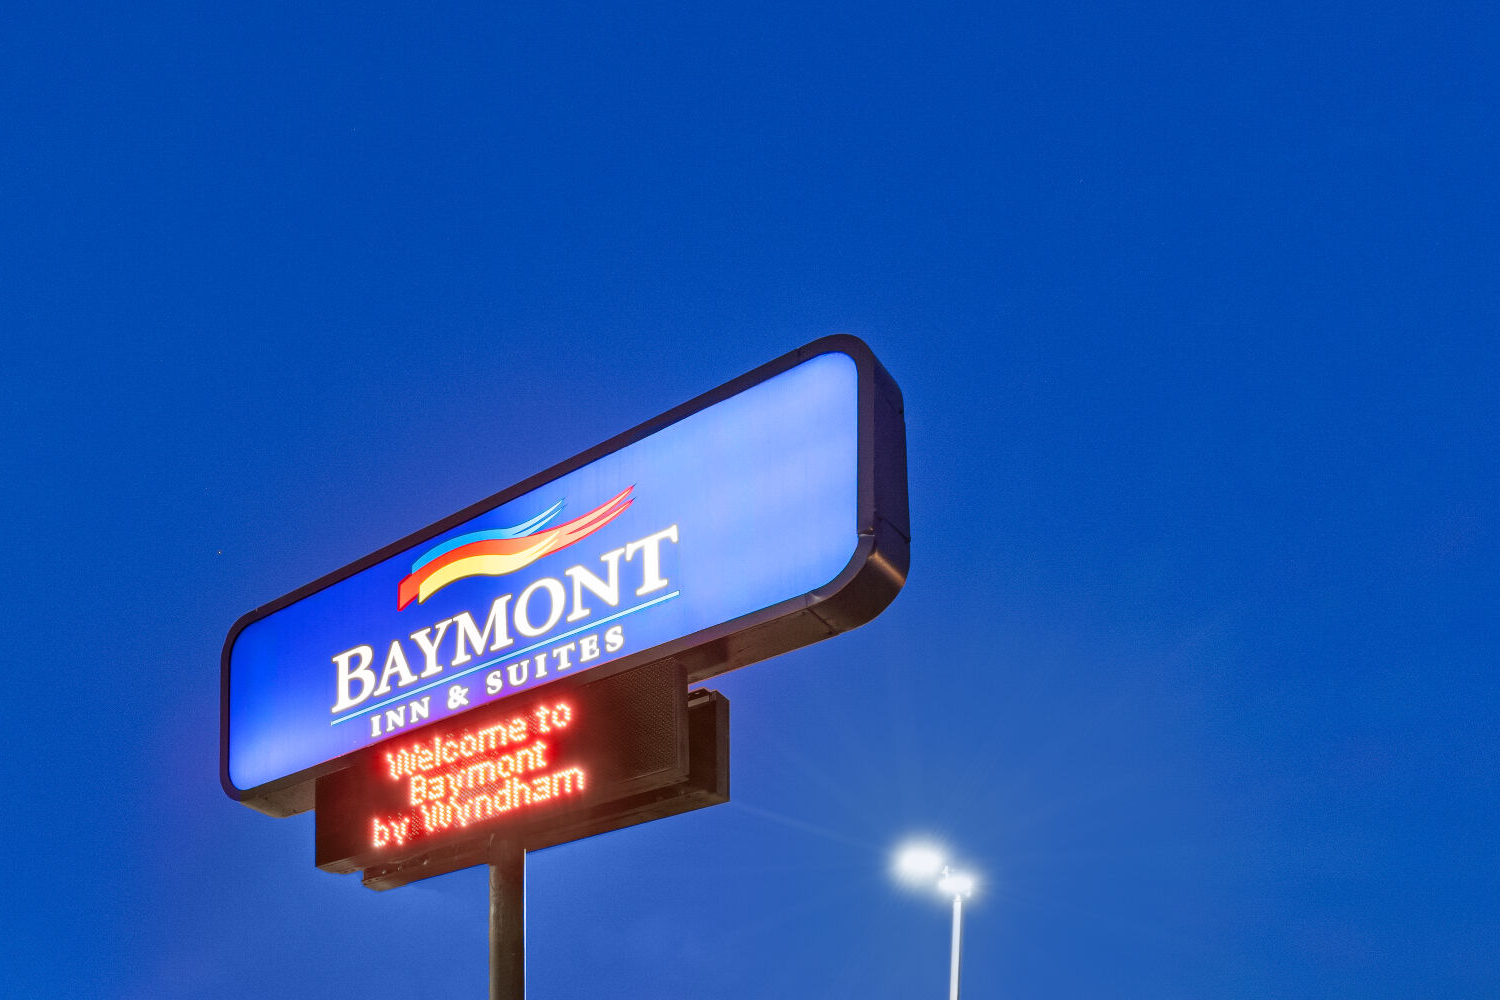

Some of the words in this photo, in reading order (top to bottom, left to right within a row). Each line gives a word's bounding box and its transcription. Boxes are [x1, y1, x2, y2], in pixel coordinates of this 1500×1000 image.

[331, 525, 678, 713] BAYMONT
[370, 697, 430, 738] INN
[447, 685, 469, 709] &
[485, 625, 625, 695] SUITES
[386, 718, 527, 780] Welcome
[534, 703, 571, 733] to
[410, 741, 547, 806] Baymont
[372, 817, 410, 848] by
[421, 767, 585, 832] Wyndham
